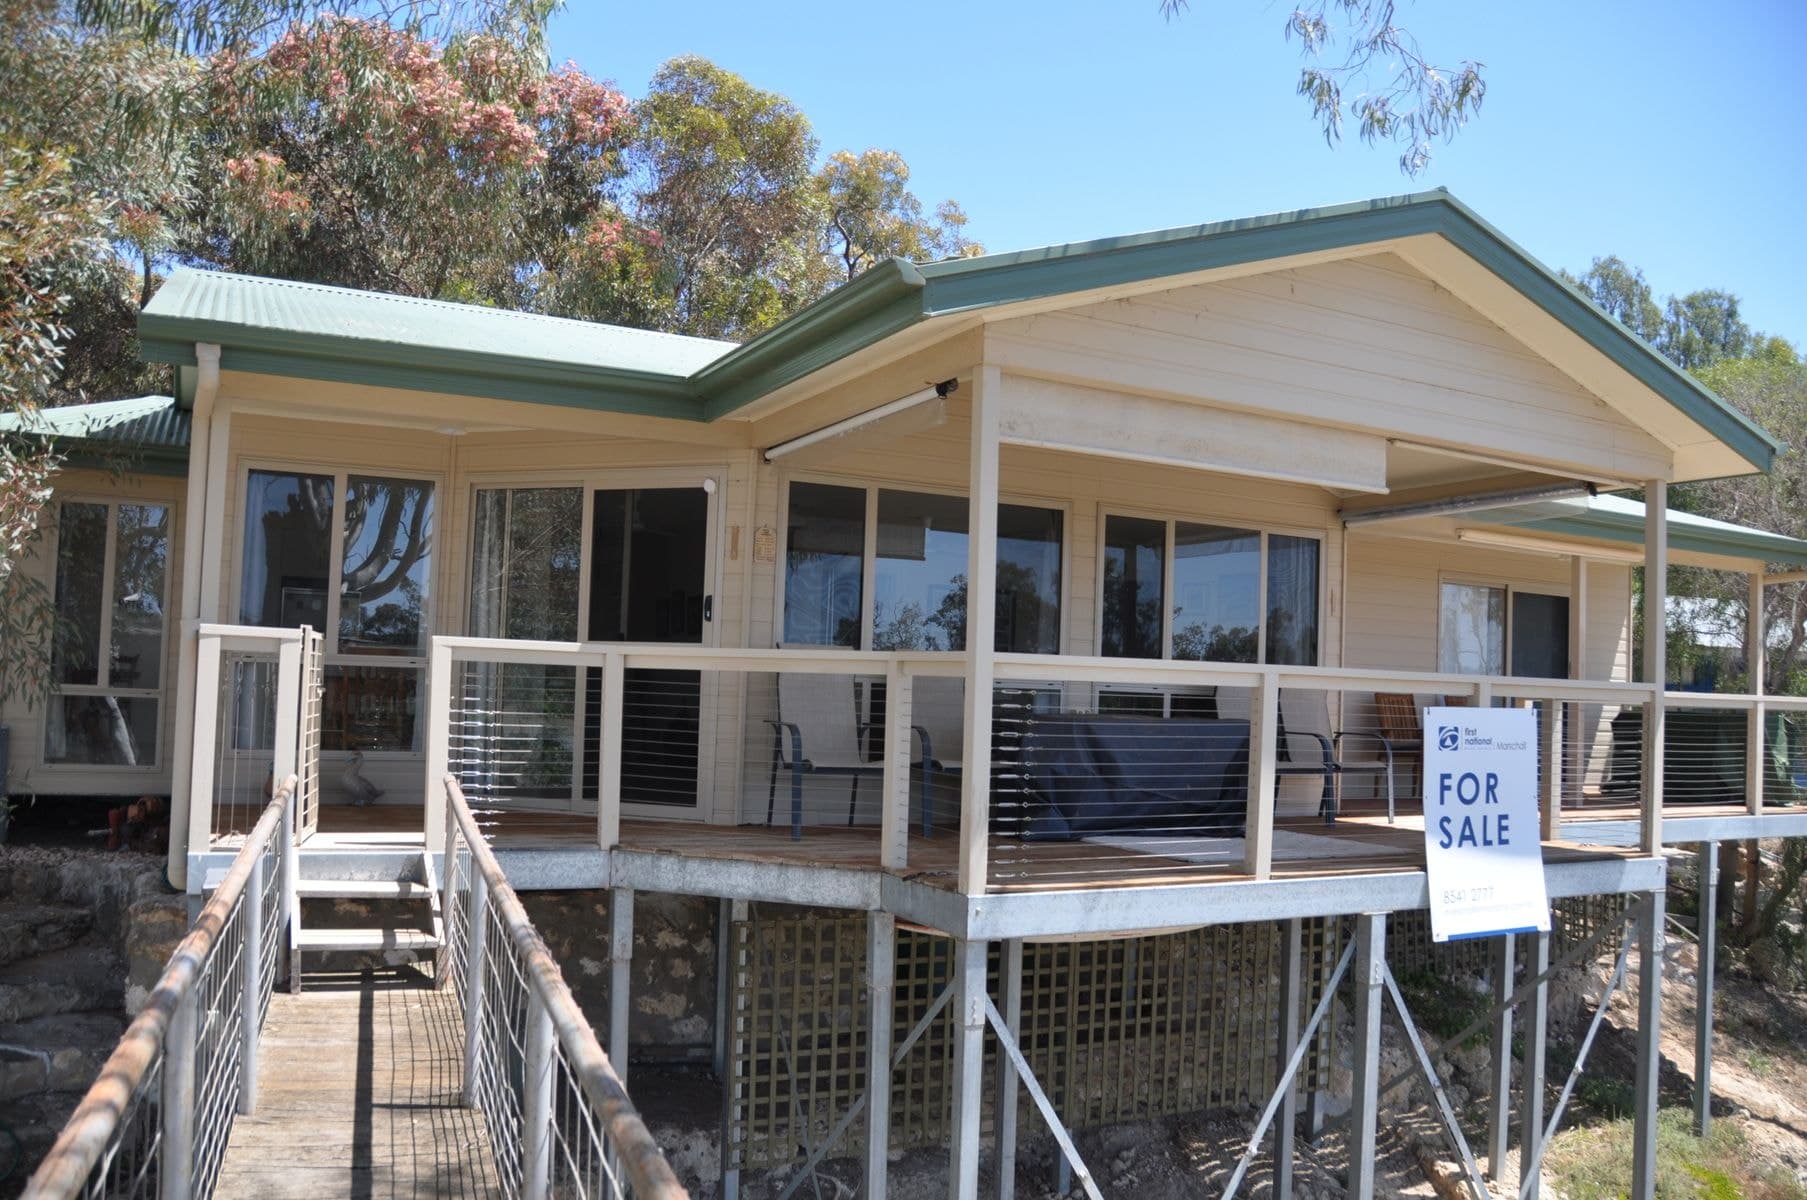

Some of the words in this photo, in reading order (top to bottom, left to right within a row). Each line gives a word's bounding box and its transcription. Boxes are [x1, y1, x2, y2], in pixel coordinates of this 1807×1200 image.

[1465, 727, 1477, 736] first
[1465, 736, 1492, 745] national
[1439, 772, 1499, 806] FOR
[1439, 813, 1510, 850] SALE
